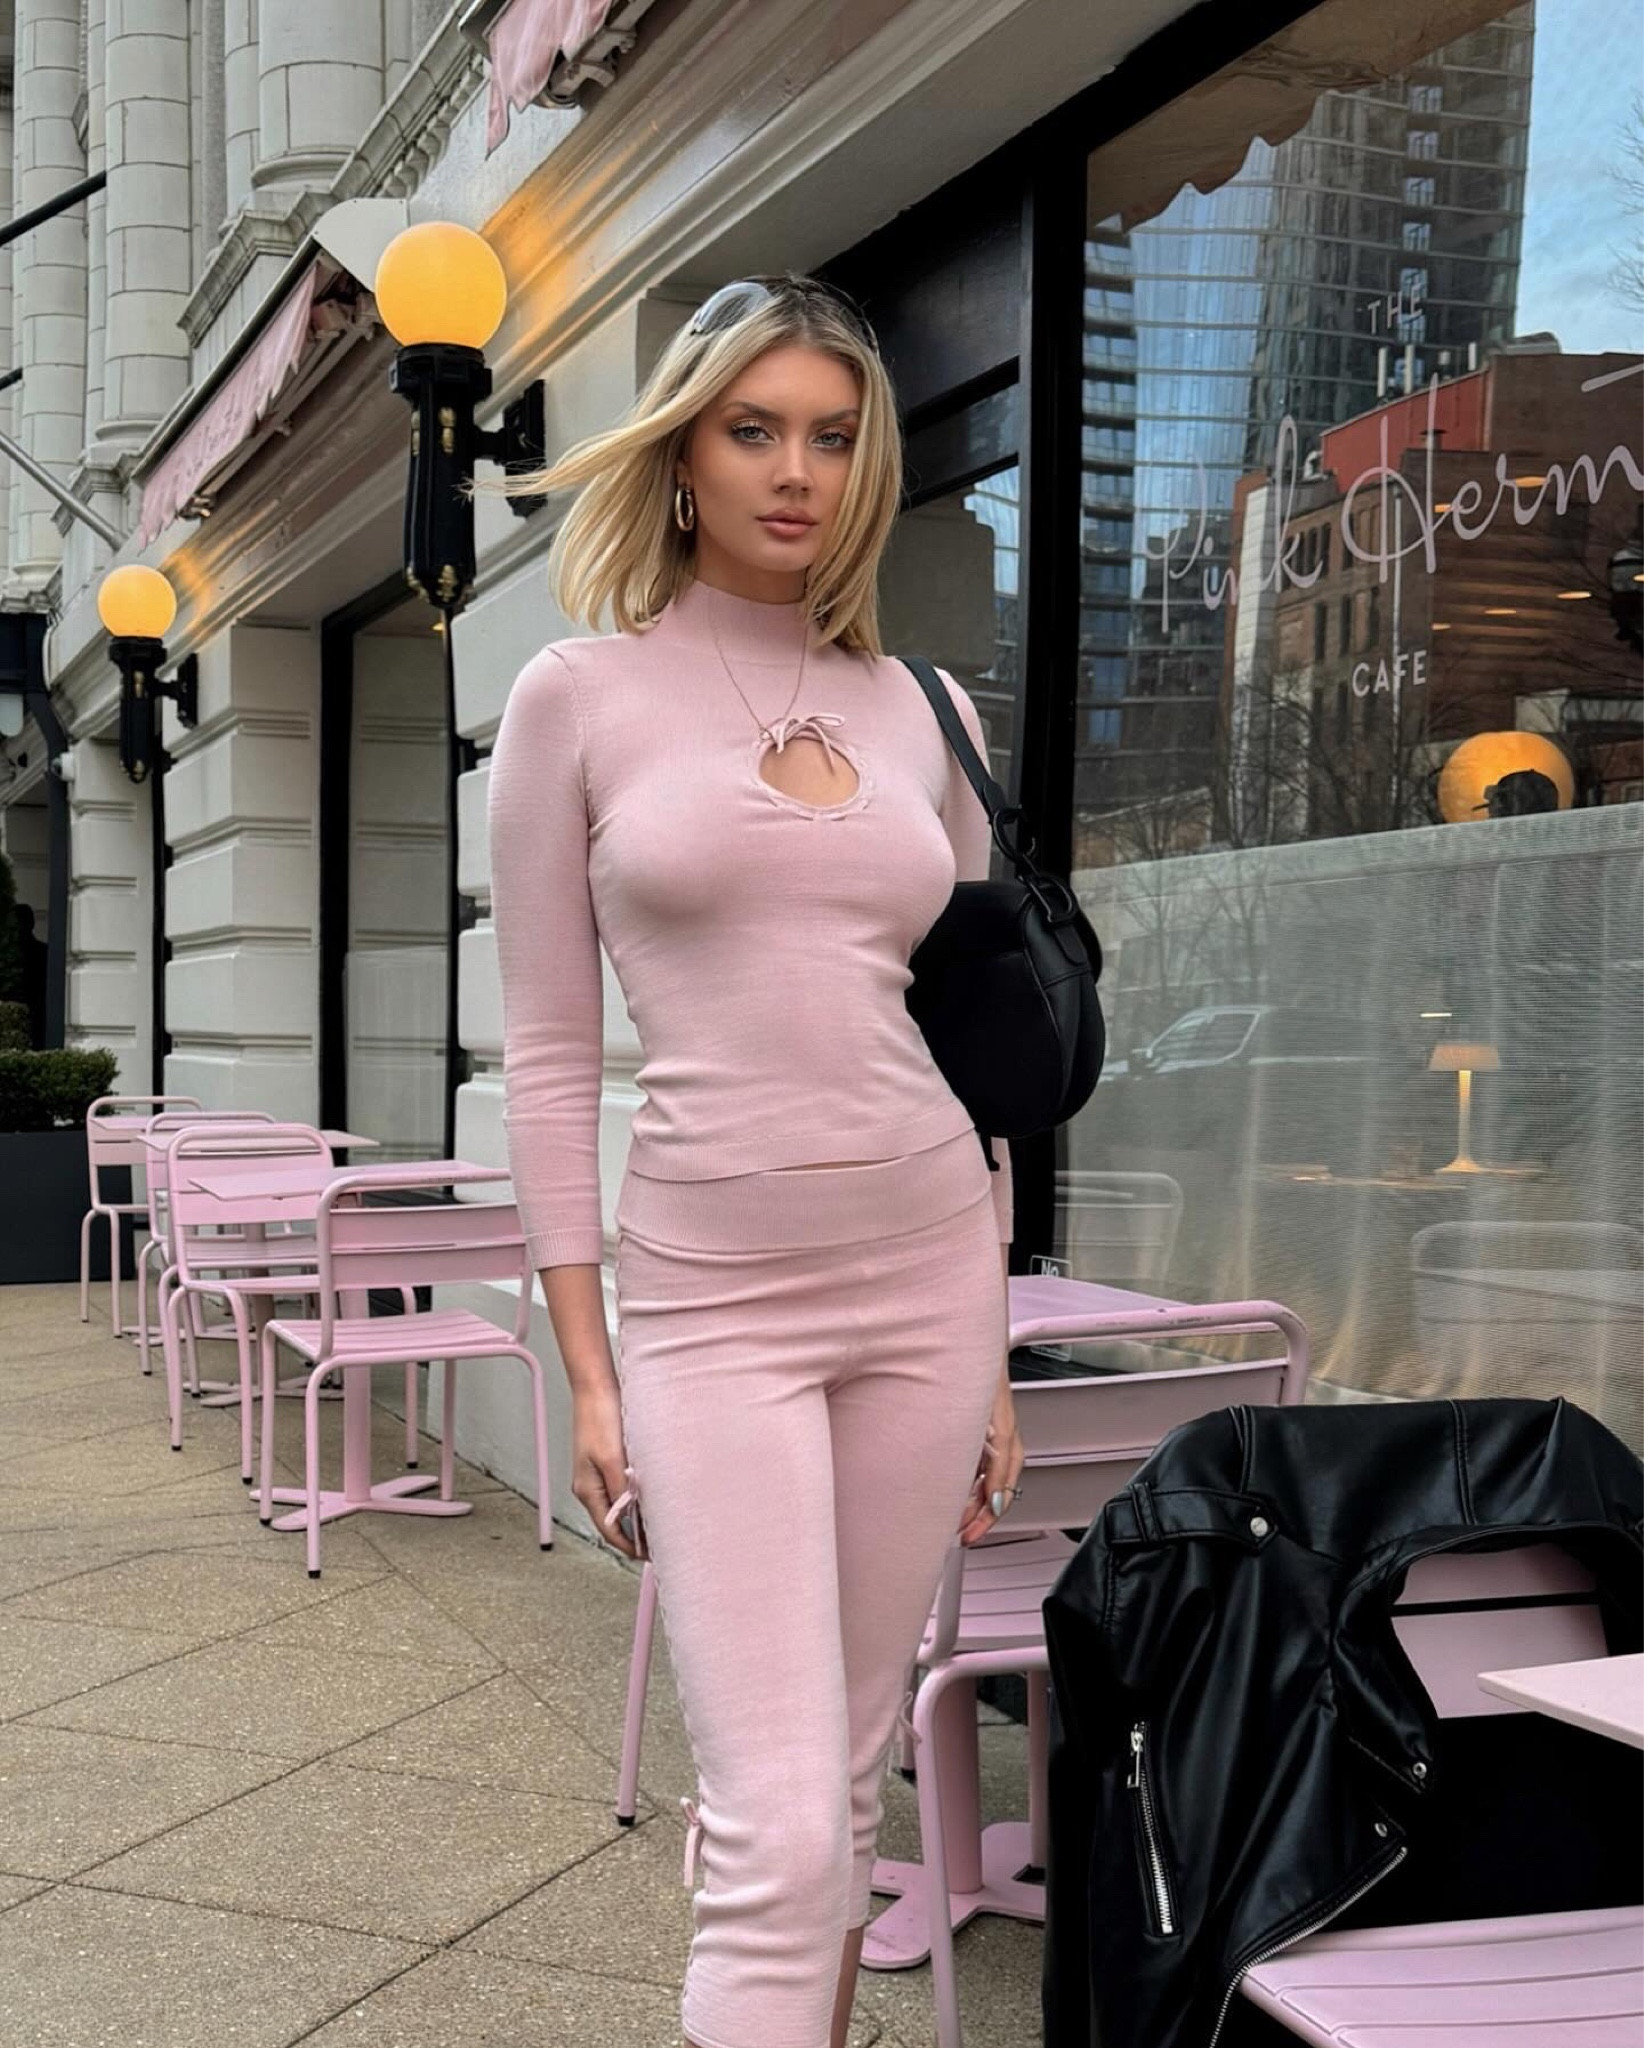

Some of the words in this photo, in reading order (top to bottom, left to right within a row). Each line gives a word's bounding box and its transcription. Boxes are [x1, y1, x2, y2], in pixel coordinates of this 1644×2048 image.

[1367, 282, 1425, 336] THE
[1134, 414, 1324, 634] Pink
[1341, 362, 1644, 583] Herm
[1352, 649, 1427, 698] CAFE
